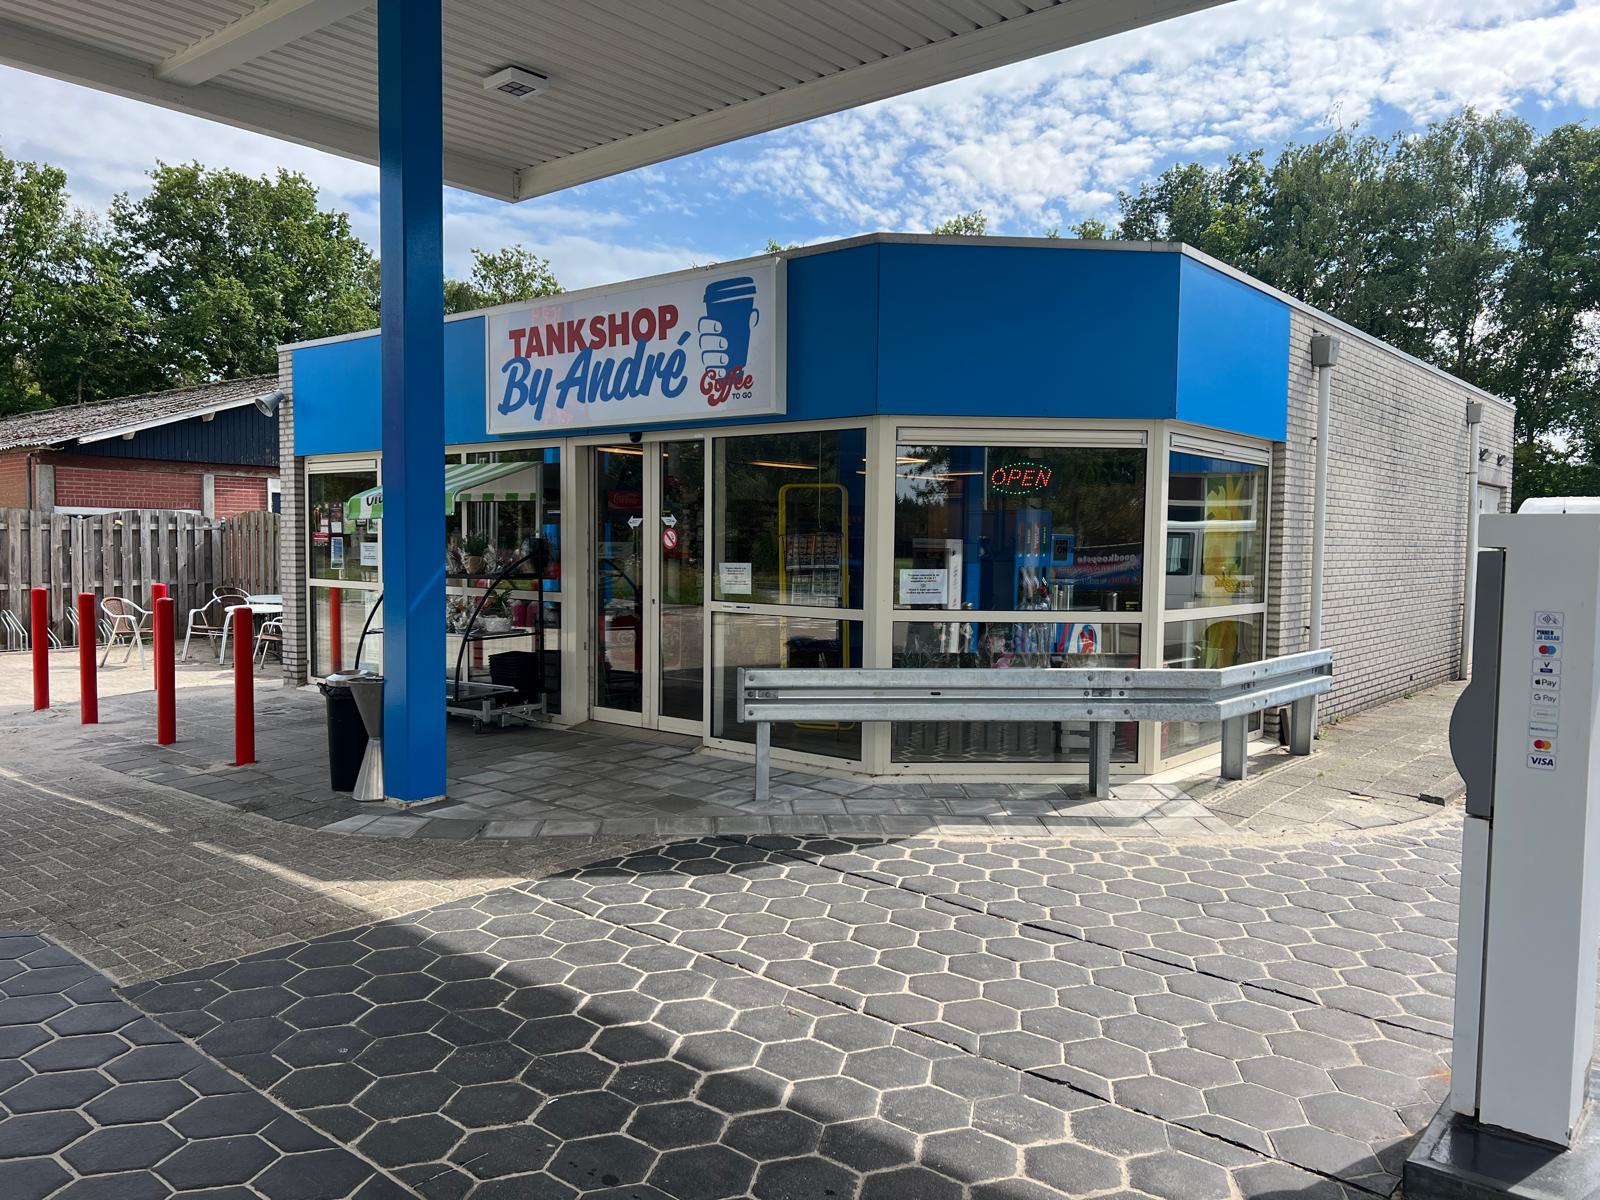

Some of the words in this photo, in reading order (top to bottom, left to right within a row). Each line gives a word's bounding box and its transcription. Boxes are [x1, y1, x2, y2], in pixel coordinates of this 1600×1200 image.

[509, 304, 679, 359] TANKSHOP
[498, 356, 553, 421] By
[556, 331, 692, 410] André
[700, 366, 753, 406] Coffee
[732, 392, 741, 400] TO
[742, 391, 753, 399] GO
[991, 469, 1053, 487] OPEN
[1541, 679, 1557, 688] Pay
[1542, 694, 1557, 703] Pay
[1530, 756, 1554, 767] VISA
